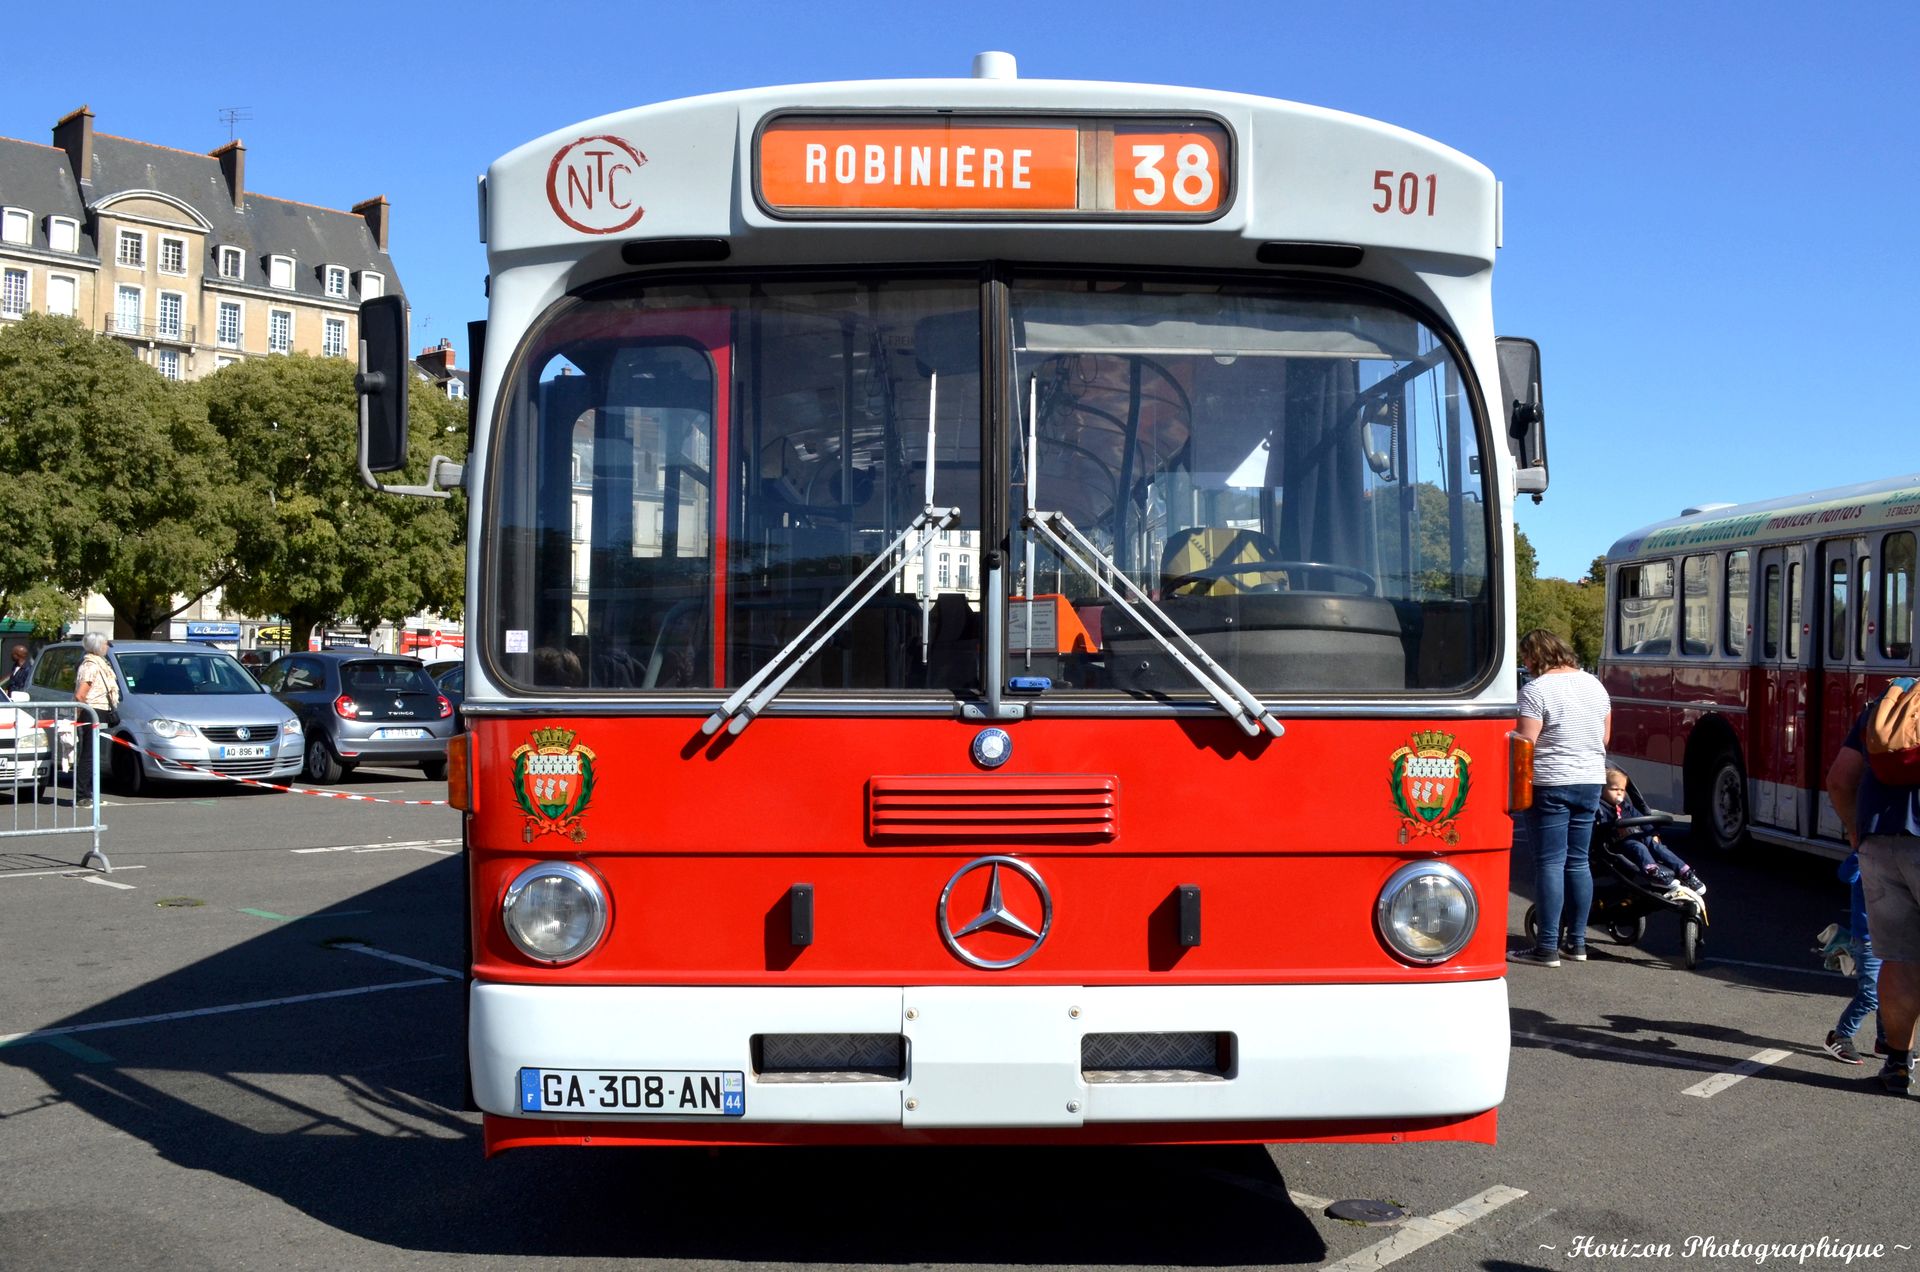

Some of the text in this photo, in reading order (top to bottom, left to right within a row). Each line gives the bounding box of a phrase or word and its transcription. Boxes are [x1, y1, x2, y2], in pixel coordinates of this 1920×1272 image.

[1132, 143, 1214, 206] 38
[1373, 170, 1437, 216] 501
[527, 1094, 534, 1103] F
[543, 1074, 721, 1109] GA-308-AN
[726, 1095, 742, 1109] 44
